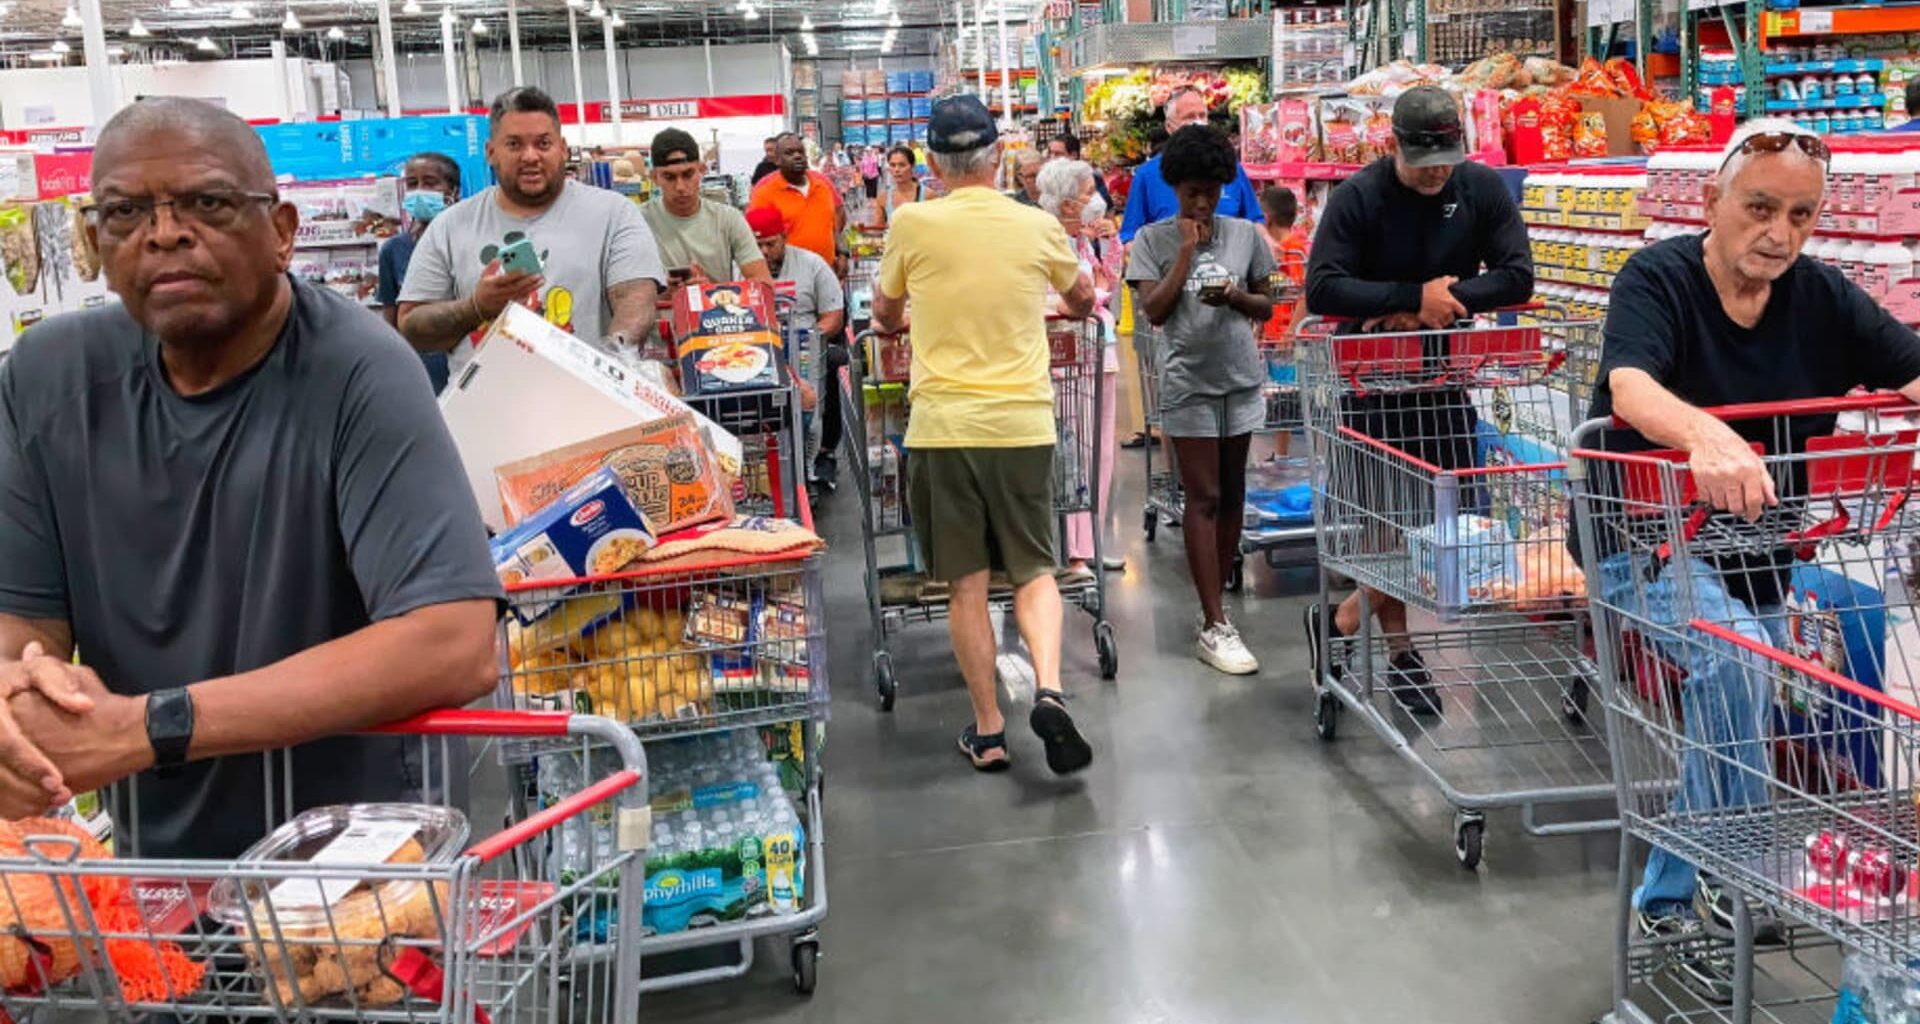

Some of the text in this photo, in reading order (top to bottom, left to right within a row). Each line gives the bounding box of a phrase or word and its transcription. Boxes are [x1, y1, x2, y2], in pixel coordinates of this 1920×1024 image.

[656, 103, 690, 116] DELI
[702, 316, 754, 329] QUAKER
[769, 840, 790, 854] 40
[643, 873, 716, 900] phyrhills
